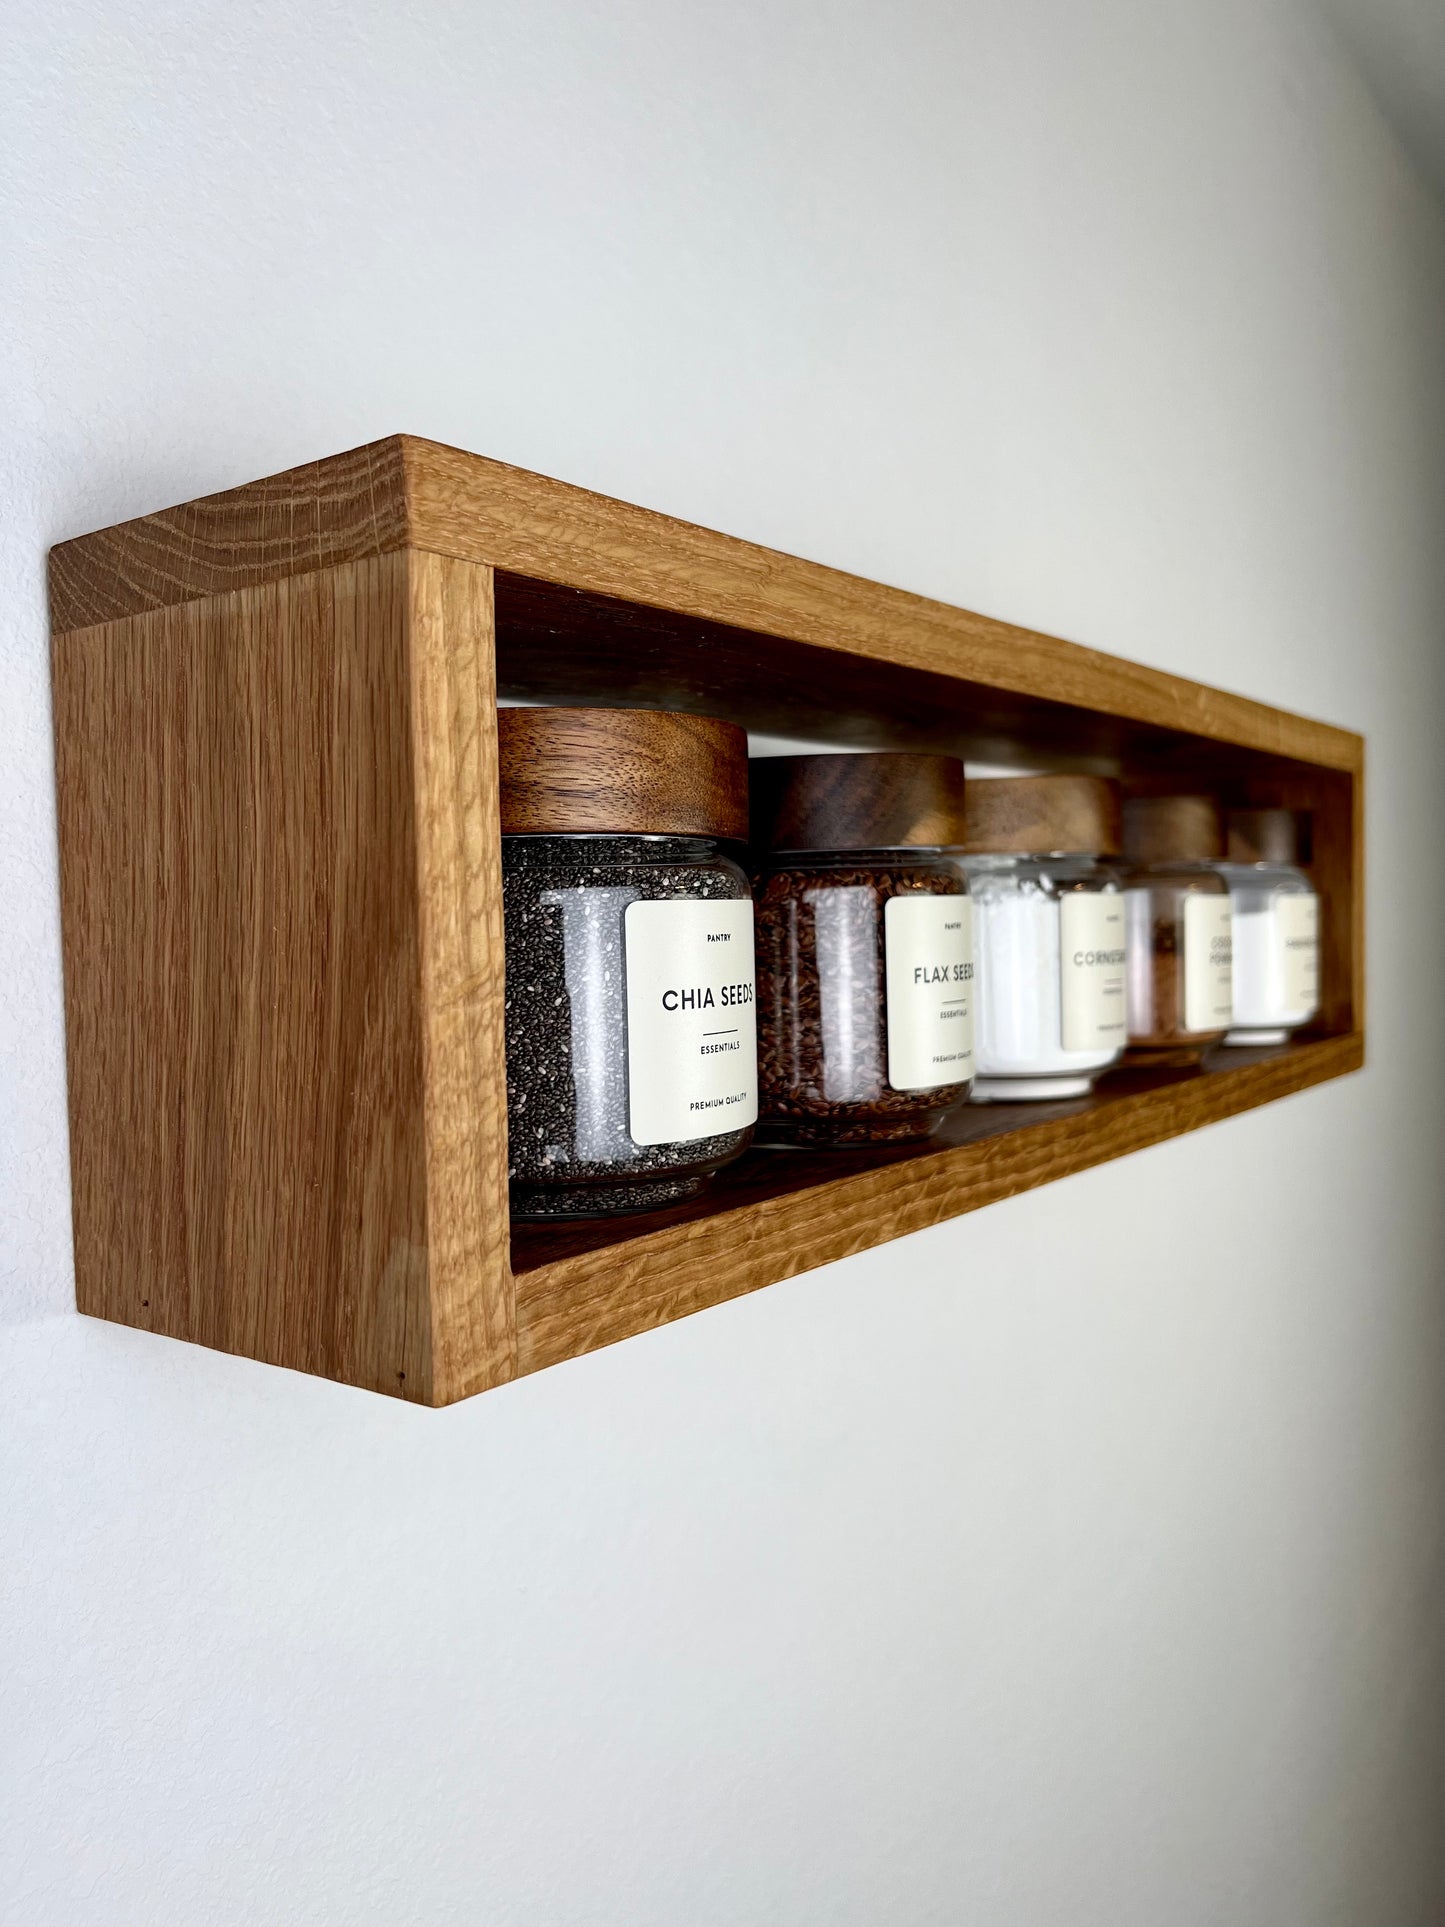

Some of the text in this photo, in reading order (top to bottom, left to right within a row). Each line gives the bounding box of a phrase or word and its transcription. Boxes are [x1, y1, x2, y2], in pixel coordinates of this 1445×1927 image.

[707, 933, 731, 942] PANTRY
[914, 965, 949, 984] FLAX
[662, 982, 753, 1011] CHIA SEEDS
[700, 1040, 740, 1055] ESSENTIALS
[690, 1092, 747, 1111] PREMIUM QUALITY
